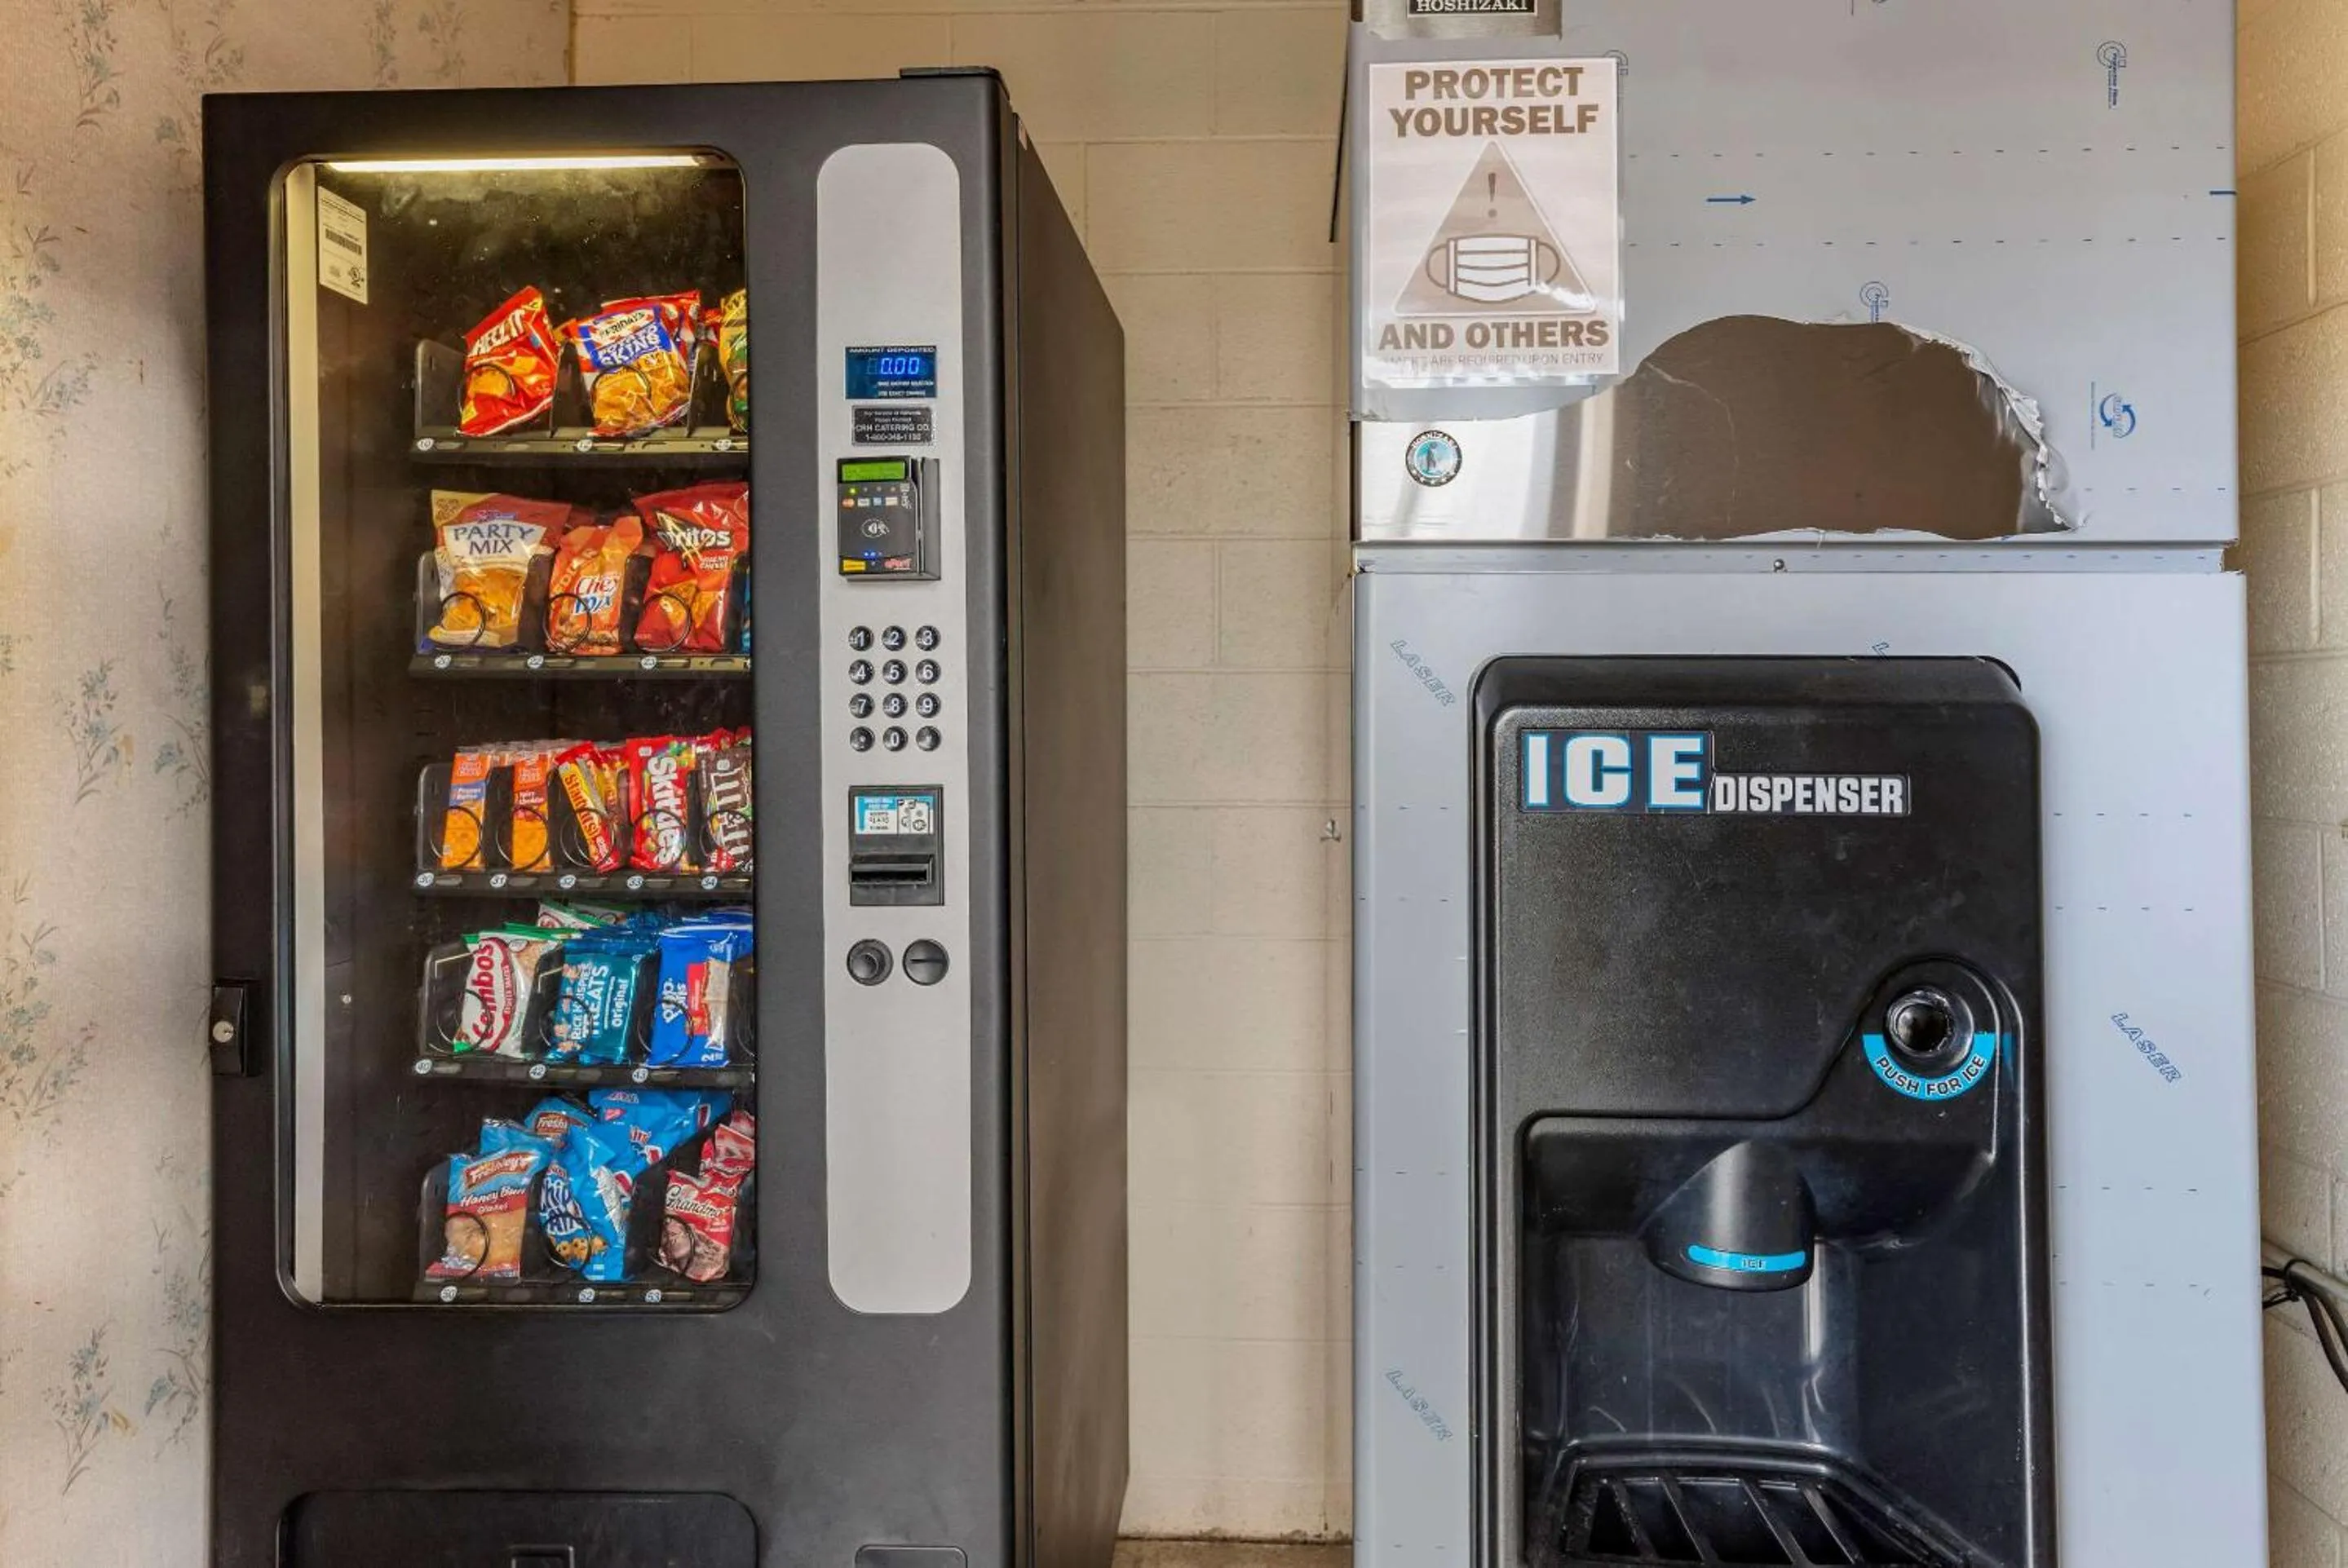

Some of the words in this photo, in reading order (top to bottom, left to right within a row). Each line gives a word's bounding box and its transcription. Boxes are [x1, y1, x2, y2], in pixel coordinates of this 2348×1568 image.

[1416, 0, 1528, 12] HOSHIZAKI
[1404, 67, 1585, 100] PROTECT
[1389, 104, 1599, 138] YOURSELF
[1378, 323, 1455, 350] AND
[1465, 320, 1610, 350] OTHERS
[1562, 352, 1605, 364] ENTRY
[453, 524, 536, 541] PARTY
[469, 539, 514, 555] MIX
[889, 631, 900, 646] 2
[922, 630, 933, 645] 3
[856, 665, 866, 680] 4
[890, 665, 899, 680] 5
[922, 665, 933, 680] 6
[1390, 638, 1456, 707] LASER
[858, 699, 866, 713] 7
[891, 698, 900, 713] 8
[922, 697, 933, 713] 9
[890, 732, 899, 746] 0
[1524, 734, 1705, 808] ICE
[1715, 776, 1904, 814] DISPENSER
[612, 978, 629, 1027] Original
[2111, 1012, 2182, 1084] LASER
[1876, 1056, 1920, 1093] PUSH
[1926, 1077, 1962, 1096] FOR
[1961, 1055, 1987, 1082] ICE
